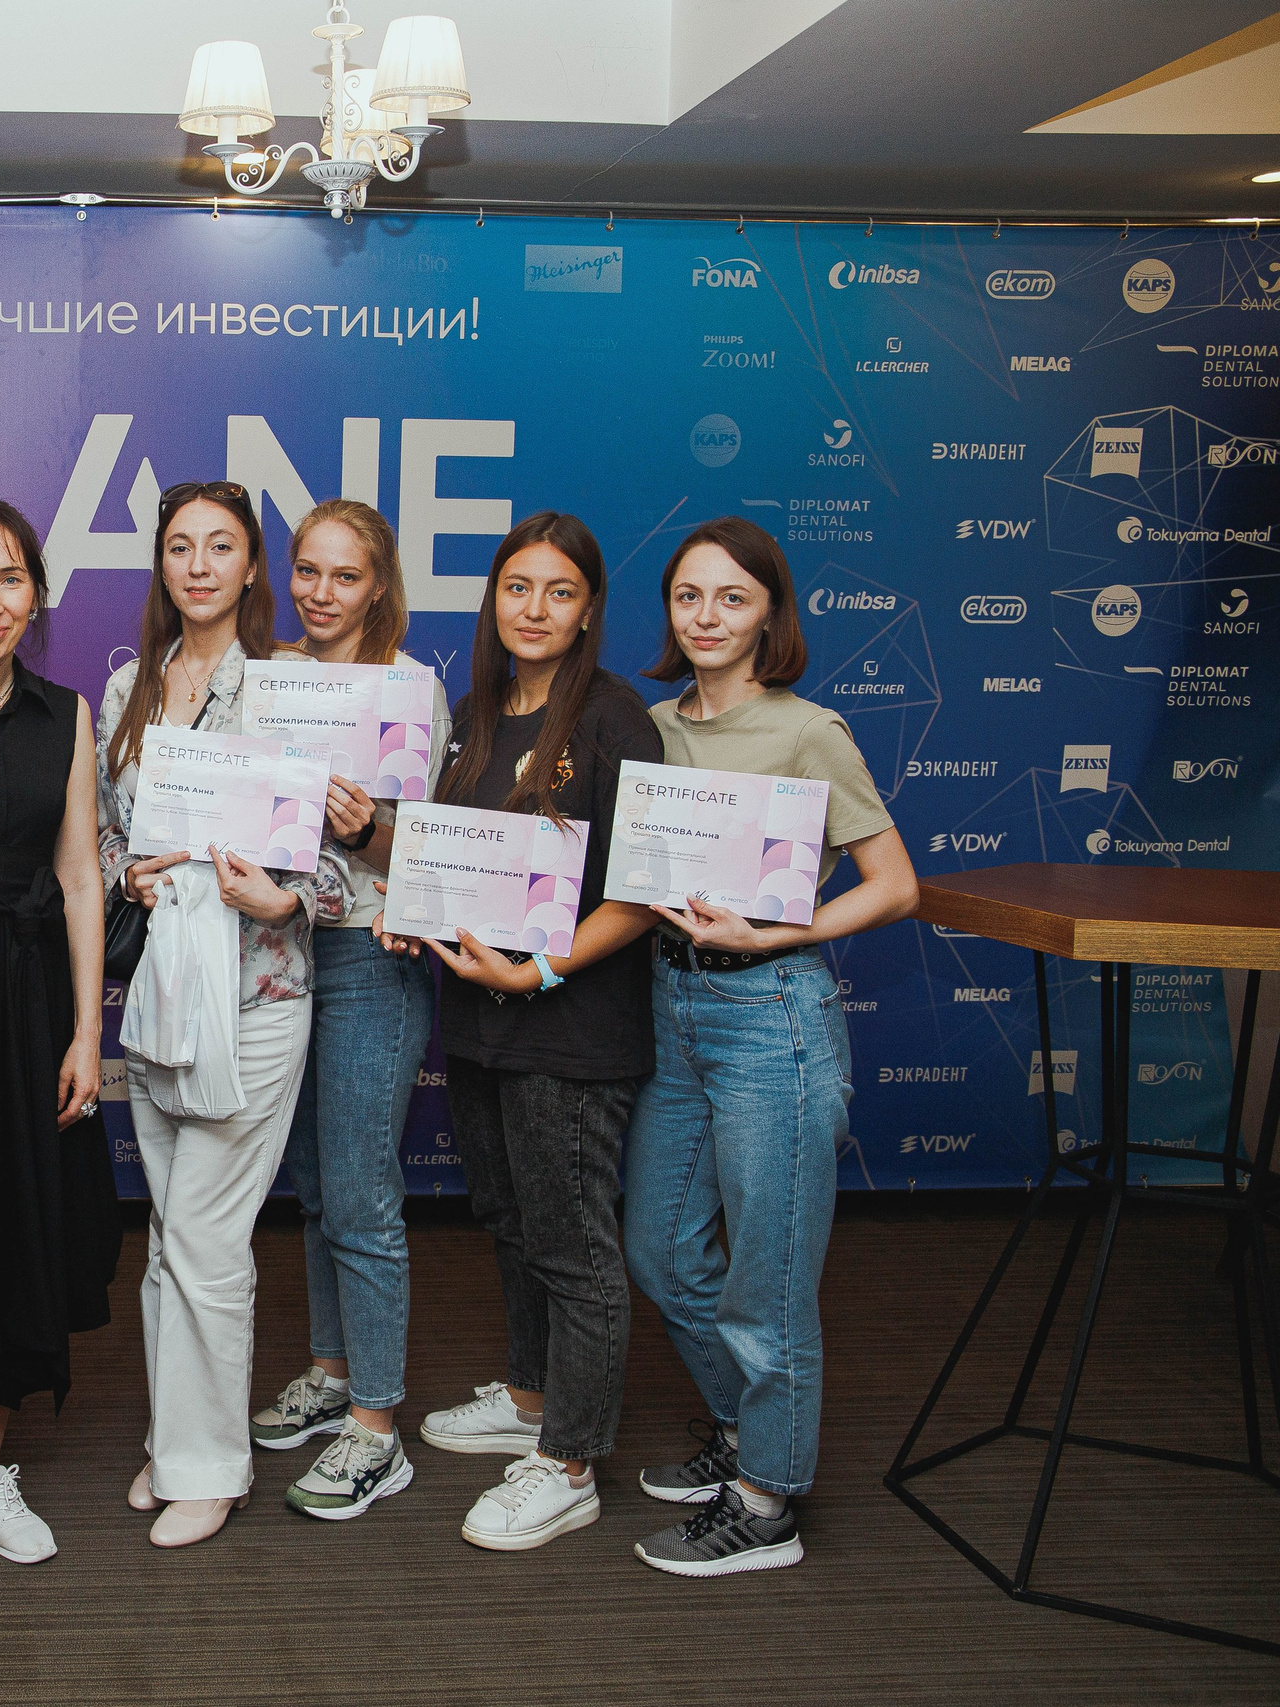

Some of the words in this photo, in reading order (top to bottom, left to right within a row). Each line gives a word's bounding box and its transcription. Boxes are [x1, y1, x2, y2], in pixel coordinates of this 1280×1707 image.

[526, 252, 621, 282] Meisinger
[858, 264, 920, 284] inibsa
[692, 269, 758, 288] FONA
[991, 271, 1050, 292] ekom
[1127, 278, 1170, 292] KAPS
[1240, 298, 1280, 311] SANO
[157, 297, 479, 345] инвестиции!
[703, 336, 743, 344] PHILIPS
[1205, 345, 1280, 357] DIPLOMA
[702, 351, 775, 369] ZOOM!
[856, 361, 929, 373] I.C.LERCHER
[1011, 356, 1070, 372] MELAG
[1203, 361, 1264, 372] DENTAL
[1201, 376, 1280, 388] SOLUTION
[695, 433, 737, 446] KAPS
[950, 444, 1026, 460] ЭКРАДЕНТ
[1095, 442, 1140, 453] ZEISS
[808, 454, 865, 467] SANOFI
[790, 500, 871, 511] DIPLOMAT
[789, 516, 847, 527] DENTAL
[788, 531, 873, 542] SOLUTIONS
[978, 520, 1031, 539] VDW
[1147, 528, 1219, 545] Tokuyama
[1225, 526, 1271, 542] Dental
[837, 591, 896, 610] inibsa
[966, 596, 1021, 616] ekom
[1096, 604, 1138, 616] KAPS
[1203, 622, 1260, 634] SANOFI
[388, 670, 429, 682] DIZANE
[1171, 667, 1249, 677] DIPLOMAT
[259, 680, 353, 694] CERTIFICATE
[834, 684, 904, 695] I.C.LERCHER
[983, 678, 1041, 692] MELAG
[1169, 681, 1226, 692] DENTAL
[1167, 696, 1251, 706] SOLUTIONS
[259, 717, 329, 726] СУХОМЛИНОВА
[158, 745, 251, 767] CERTIFICATE
[285, 747, 328, 760] DIZANE
[923, 761, 998, 777] ЭКРАДЕНТ
[1064, 757, 1108, 770] ZEISS
[154, 782, 190, 794] СИЗОВА
[192, 786, 214, 796] Анна
[635, 783, 737, 806] CERTIFICATE
[777, 783, 823, 798] DIZANE
[411, 821, 505, 842] CERTIFICATE
[631, 822, 692, 836] ОСКОЛКОВА
[695, 831, 720, 840] Анна
[951, 834, 1002, 852] VDW
[1114, 839, 1183, 854] Tokuyama
[1188, 836, 1230, 852] Dental
[407, 858, 477, 873] ПОТРЕБНИКОВА
[479, 868, 523, 878] Анастасия
[1136, 975, 1213, 986] DIPLOMAT
[954, 988, 1011, 1002] MELAG
[1134, 988, 1189, 999] DENTAL
[1131, 1002, 1212, 1013] SOLUTIONS
[895, 1067, 968, 1082] ЭКРАДЕНТ
[921, 1134, 971, 1152] VDW
